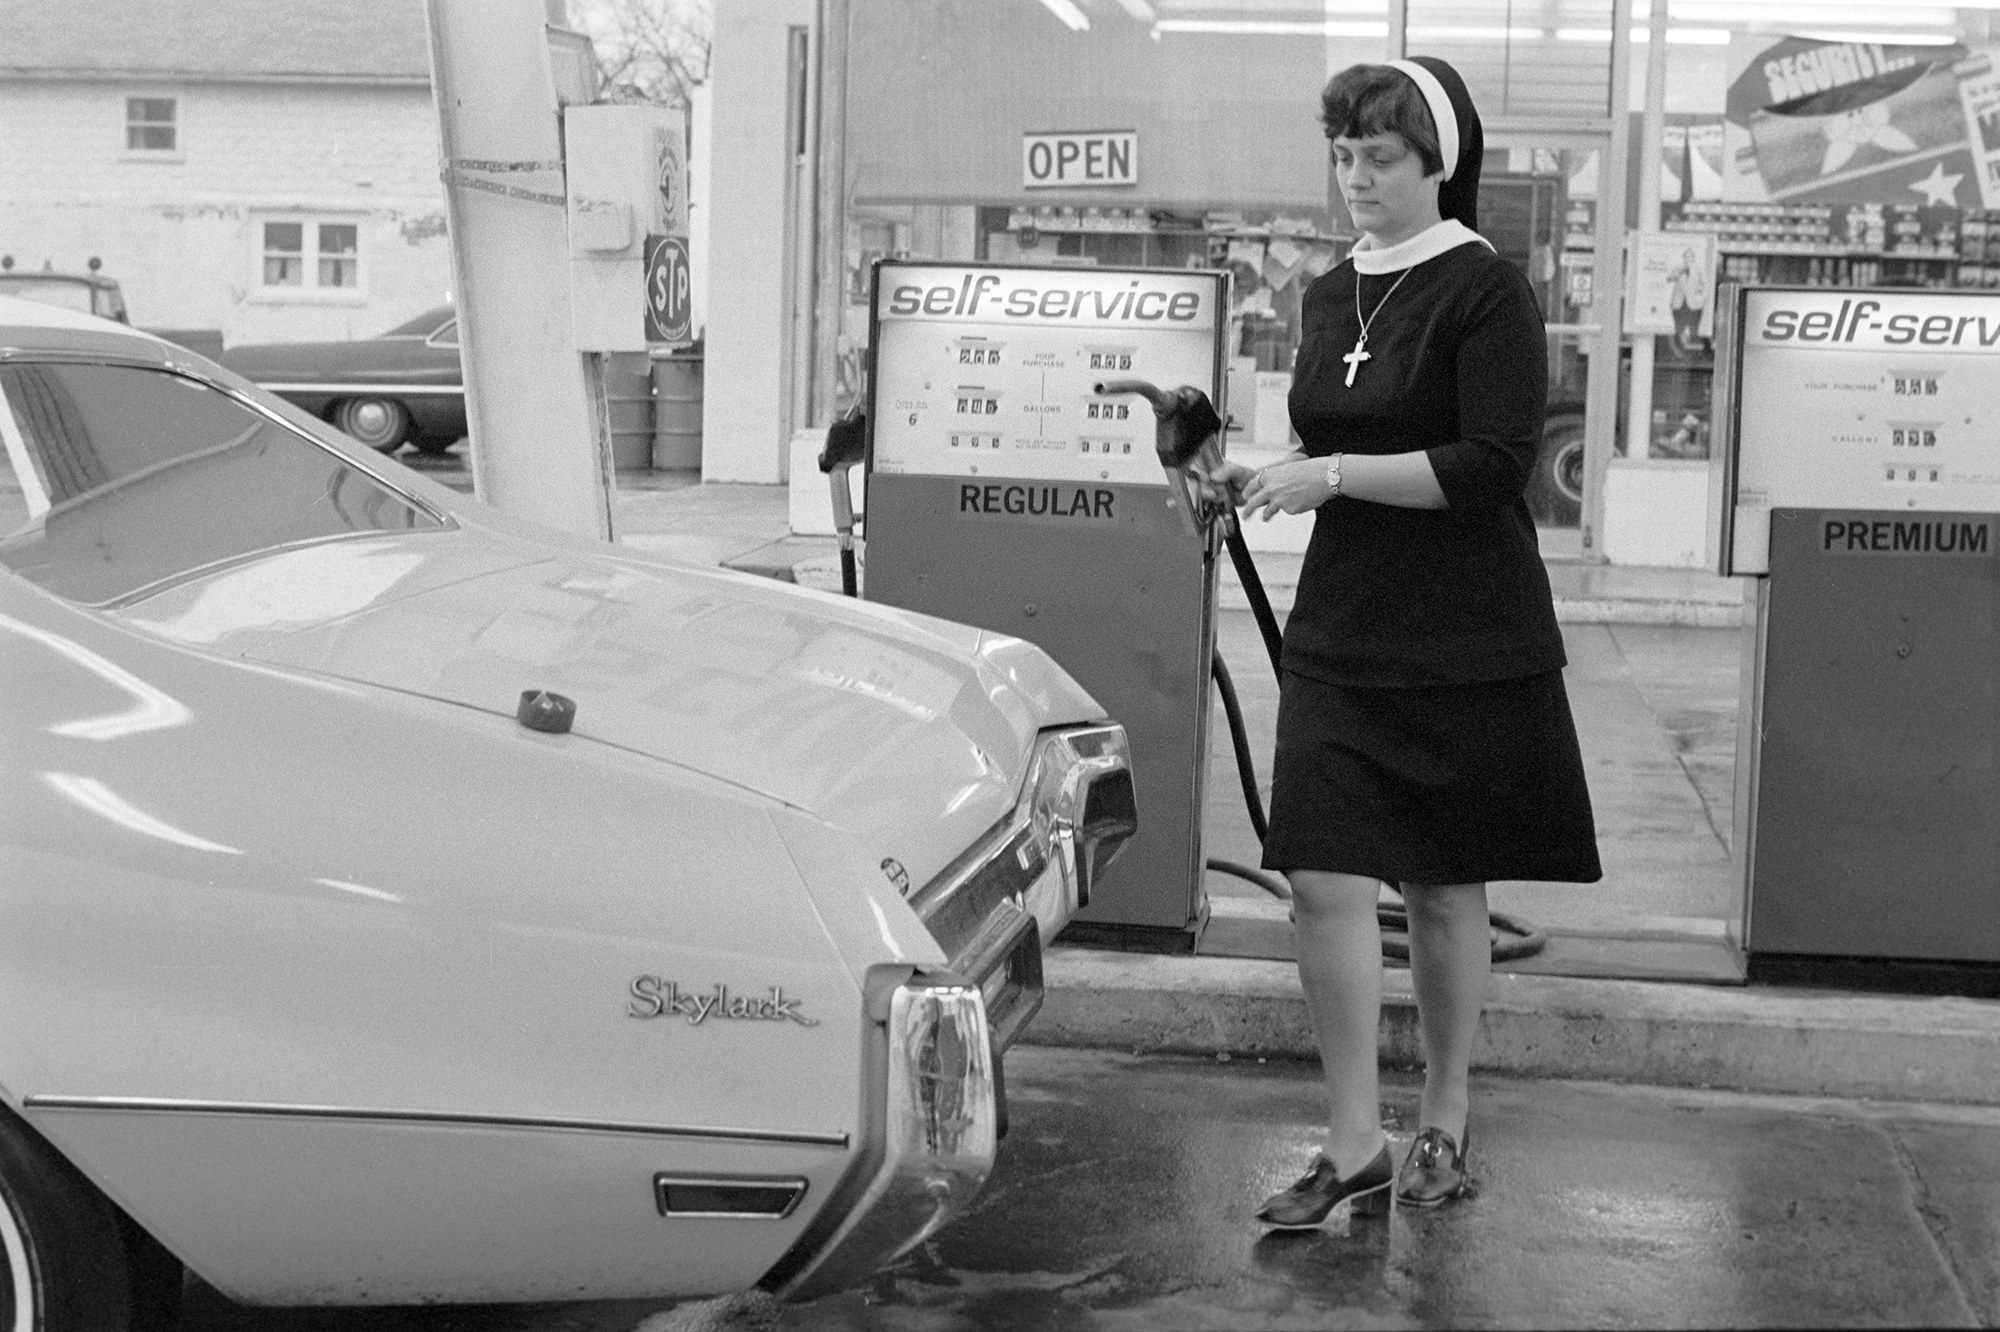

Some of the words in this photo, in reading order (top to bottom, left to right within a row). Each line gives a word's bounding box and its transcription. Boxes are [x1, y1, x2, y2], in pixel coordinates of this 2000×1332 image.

[1029, 140, 1129, 179] OPEN
[655, 248, 688, 319] STP
[889, 274, 1200, 321] self-service
[908, 412, 917, 426] 6
[960, 484, 1114, 518] REGULAR
[1823, 520, 1989, 552] PREMIUM
[628, 975, 821, 1027] Skylark
